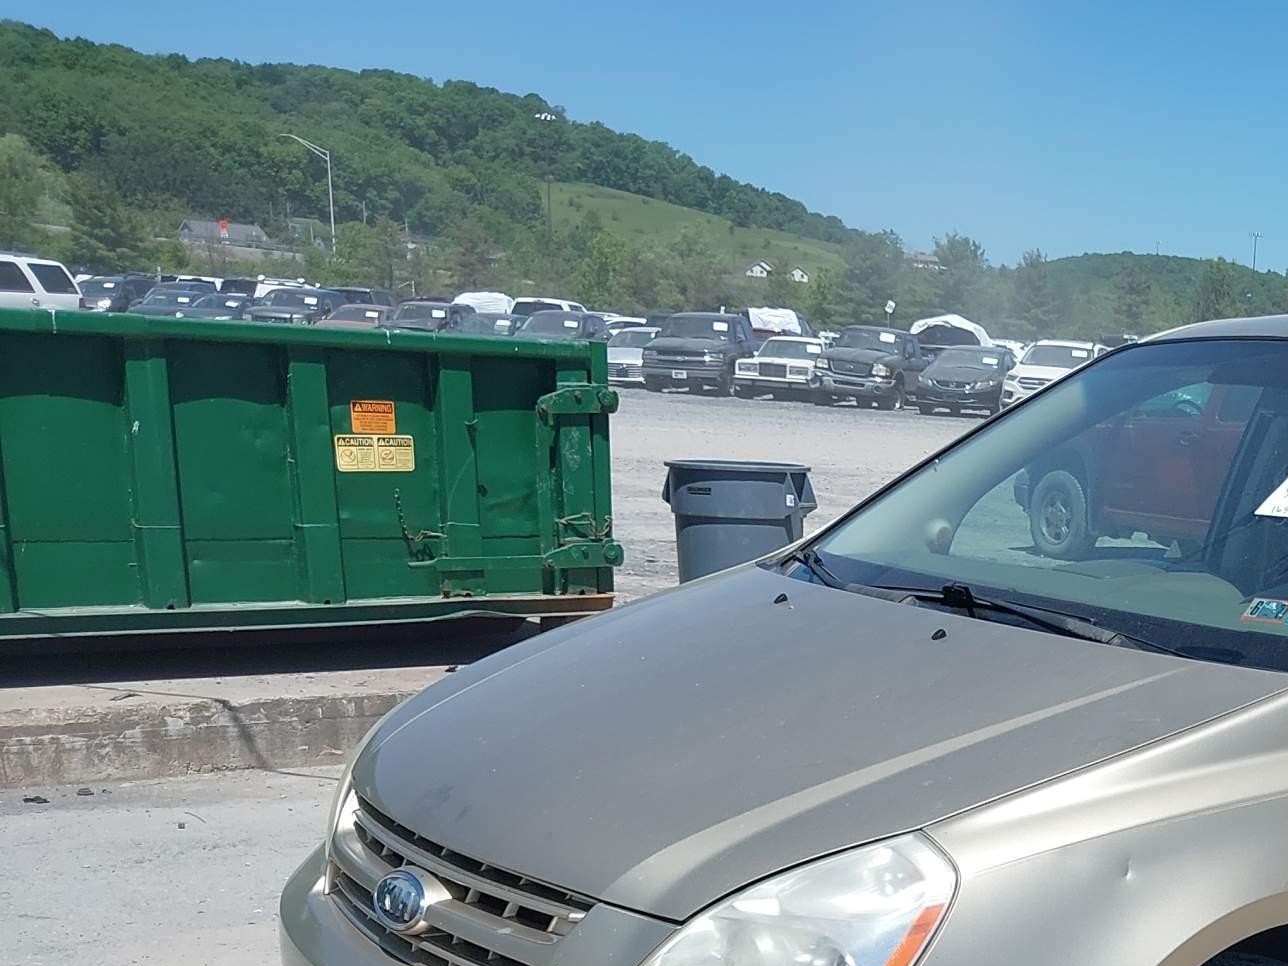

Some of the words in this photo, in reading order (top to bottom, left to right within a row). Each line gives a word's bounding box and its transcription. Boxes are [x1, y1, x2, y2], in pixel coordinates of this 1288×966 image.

[362, 403, 392, 413] WARNING
[345, 438, 373, 447] CAUTION
[385, 439, 412, 447] CAUTION
[1250, 601, 1265, 616] 6
